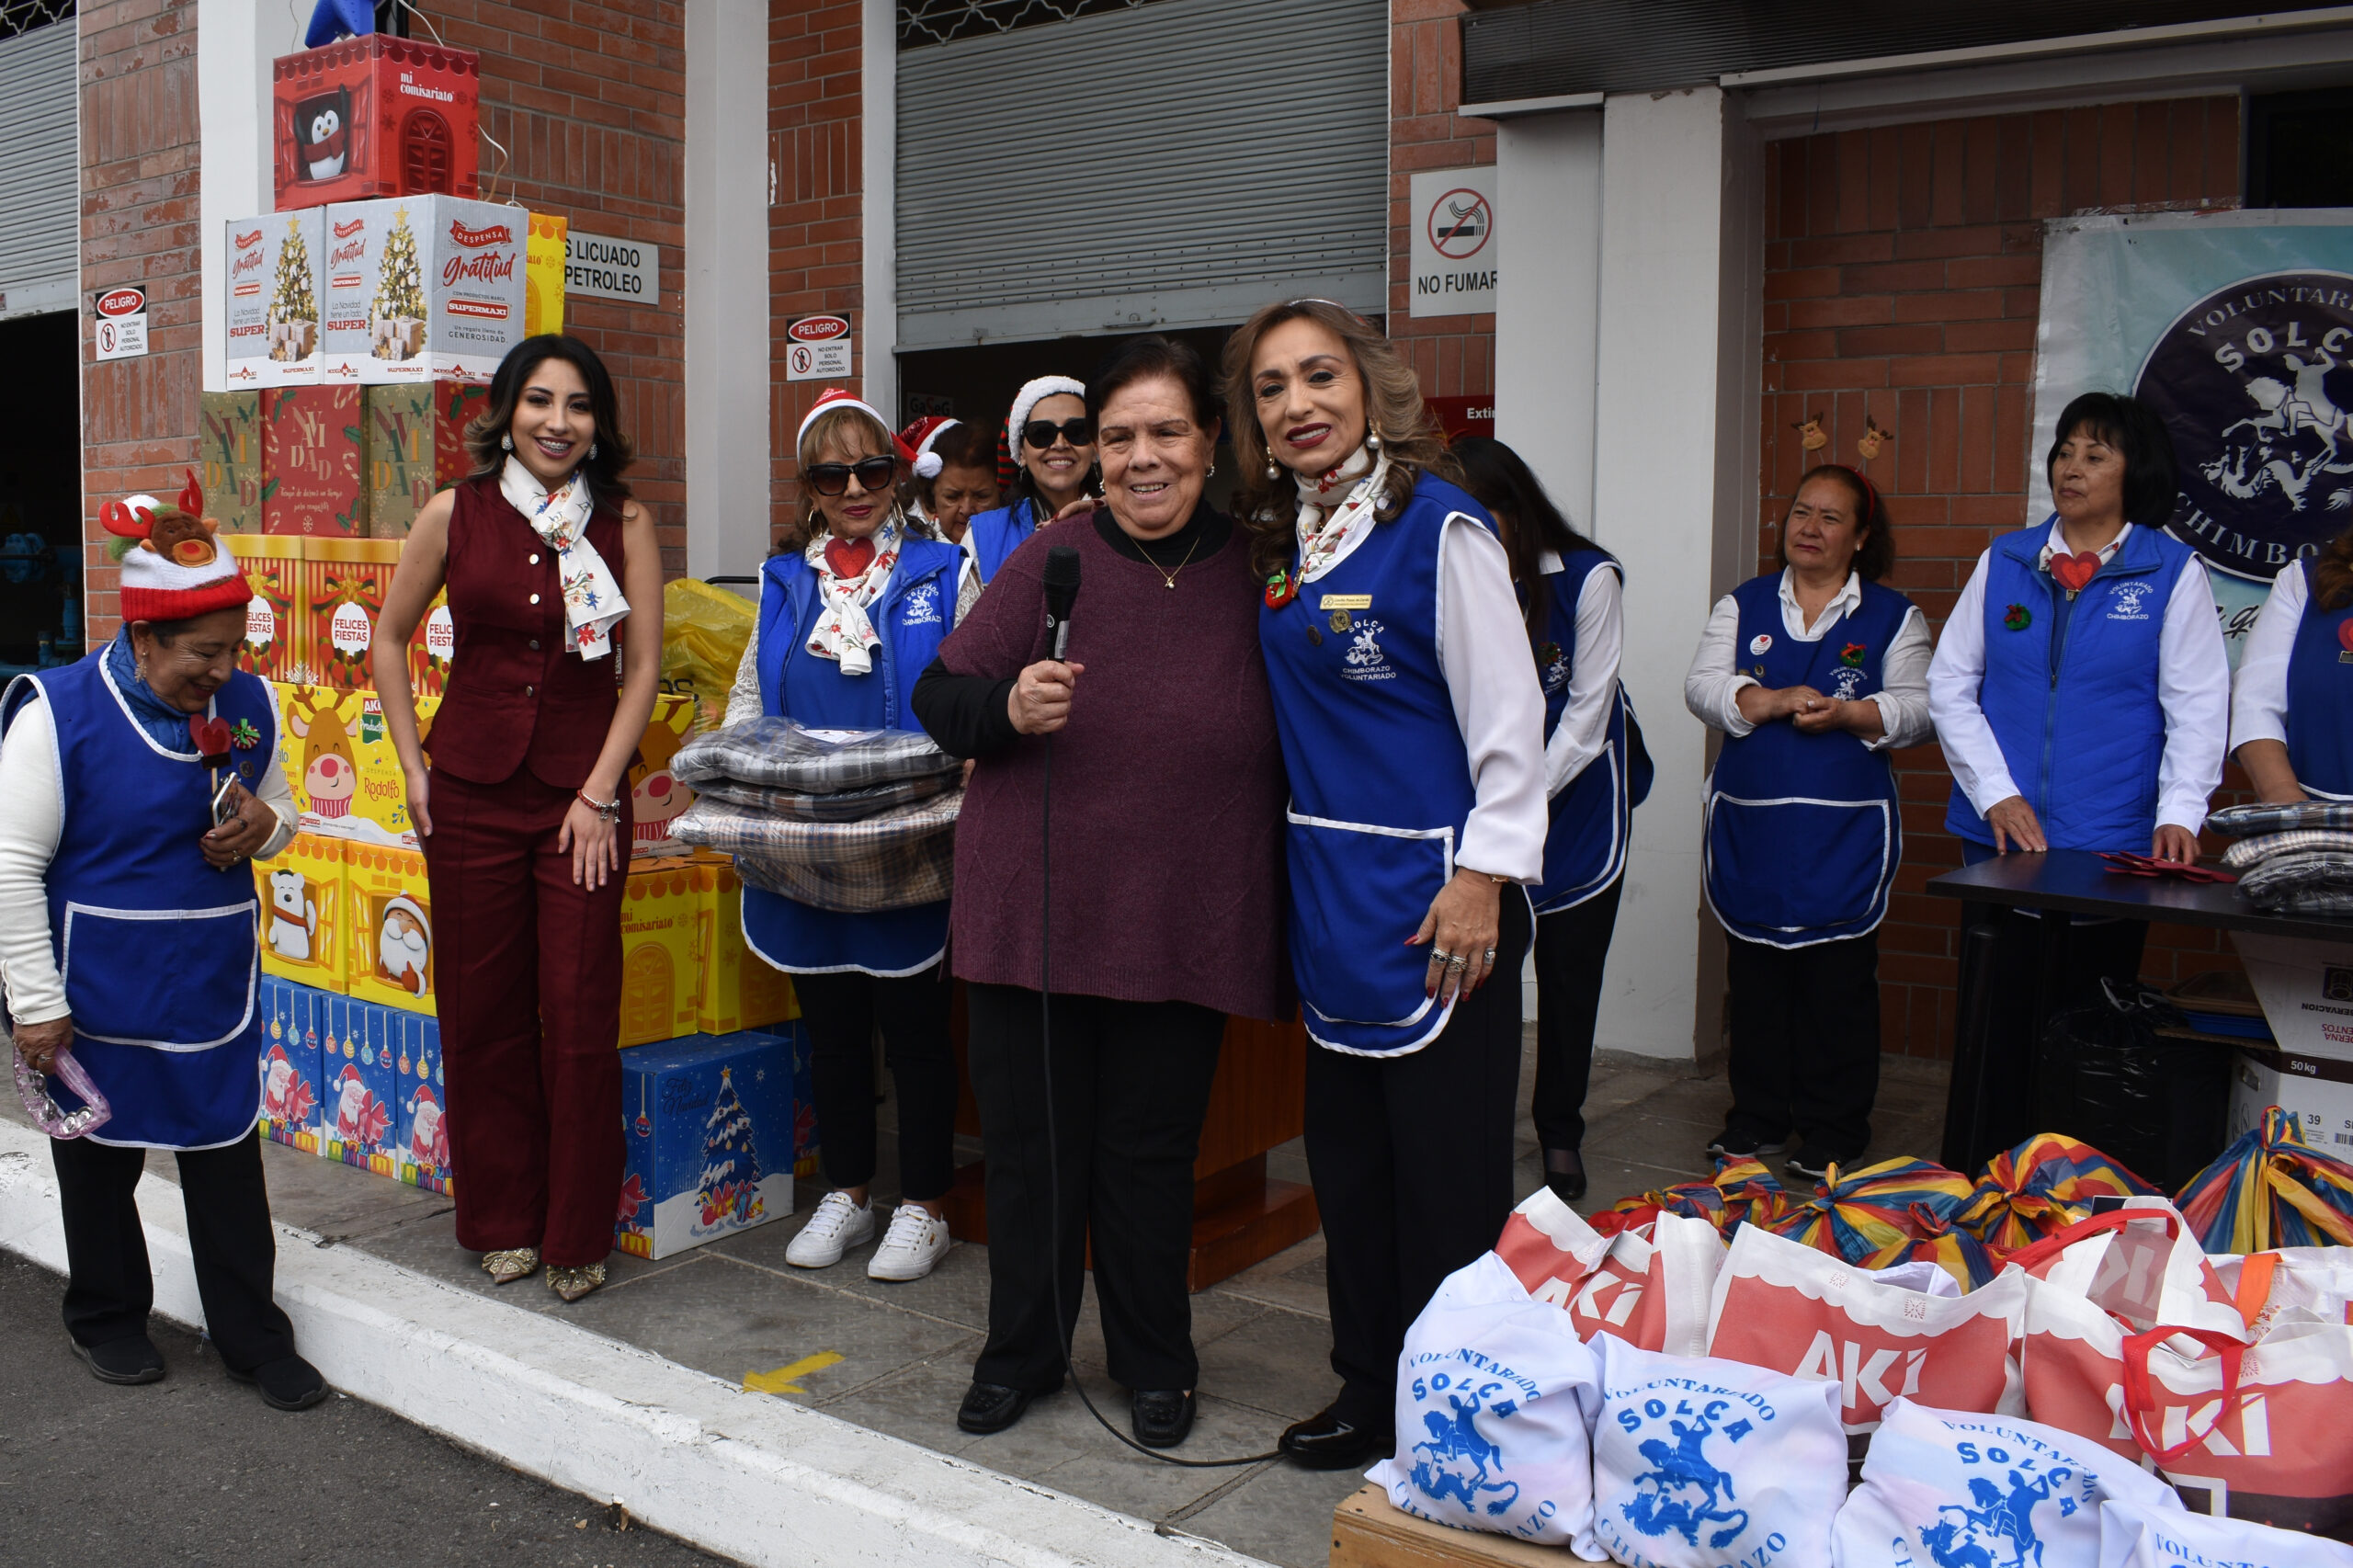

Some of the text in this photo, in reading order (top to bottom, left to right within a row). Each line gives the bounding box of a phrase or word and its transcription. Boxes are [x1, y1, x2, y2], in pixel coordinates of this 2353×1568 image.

[401, 72, 413, 84] mi
[400, 84, 453, 102] comisariato
[458, 232, 503, 244] DESPENSA
[577, 240, 641, 268] LICUADO
[443, 251, 516, 287] gratitud
[564, 266, 642, 293] PETROLEO
[1418, 270, 1497, 295] NO FUMAR
[105, 295, 137, 310] PELIGRO
[449, 303, 506, 315] SUPERMAXI
[230, 324, 265, 337] SUPER
[327, 320, 367, 331] SUPER
[798, 322, 838, 335] PELIGRO
[335, 619, 368, 631] FELICES
[1348, 619, 1384, 633] SOLCA
[335, 630, 367, 642] FIESTAS
[1343, 665, 1391, 674] CHIMBORAZO
[364, 777, 400, 801] Rodolfo
[620, 908, 632, 922] mi
[620, 916, 673, 935] comisariato
[2290, 1060, 2316, 1074] 50 kg
[2307, 1114, 2321, 1125] 39
[1412, 1372, 1518, 1419] SOLCA
[1604, 1378, 1776, 1422] VOLUNTARIADO
[1617, 1398, 1754, 1444] SOLCA
[1957, 1441, 2079, 1517] SOLCA
